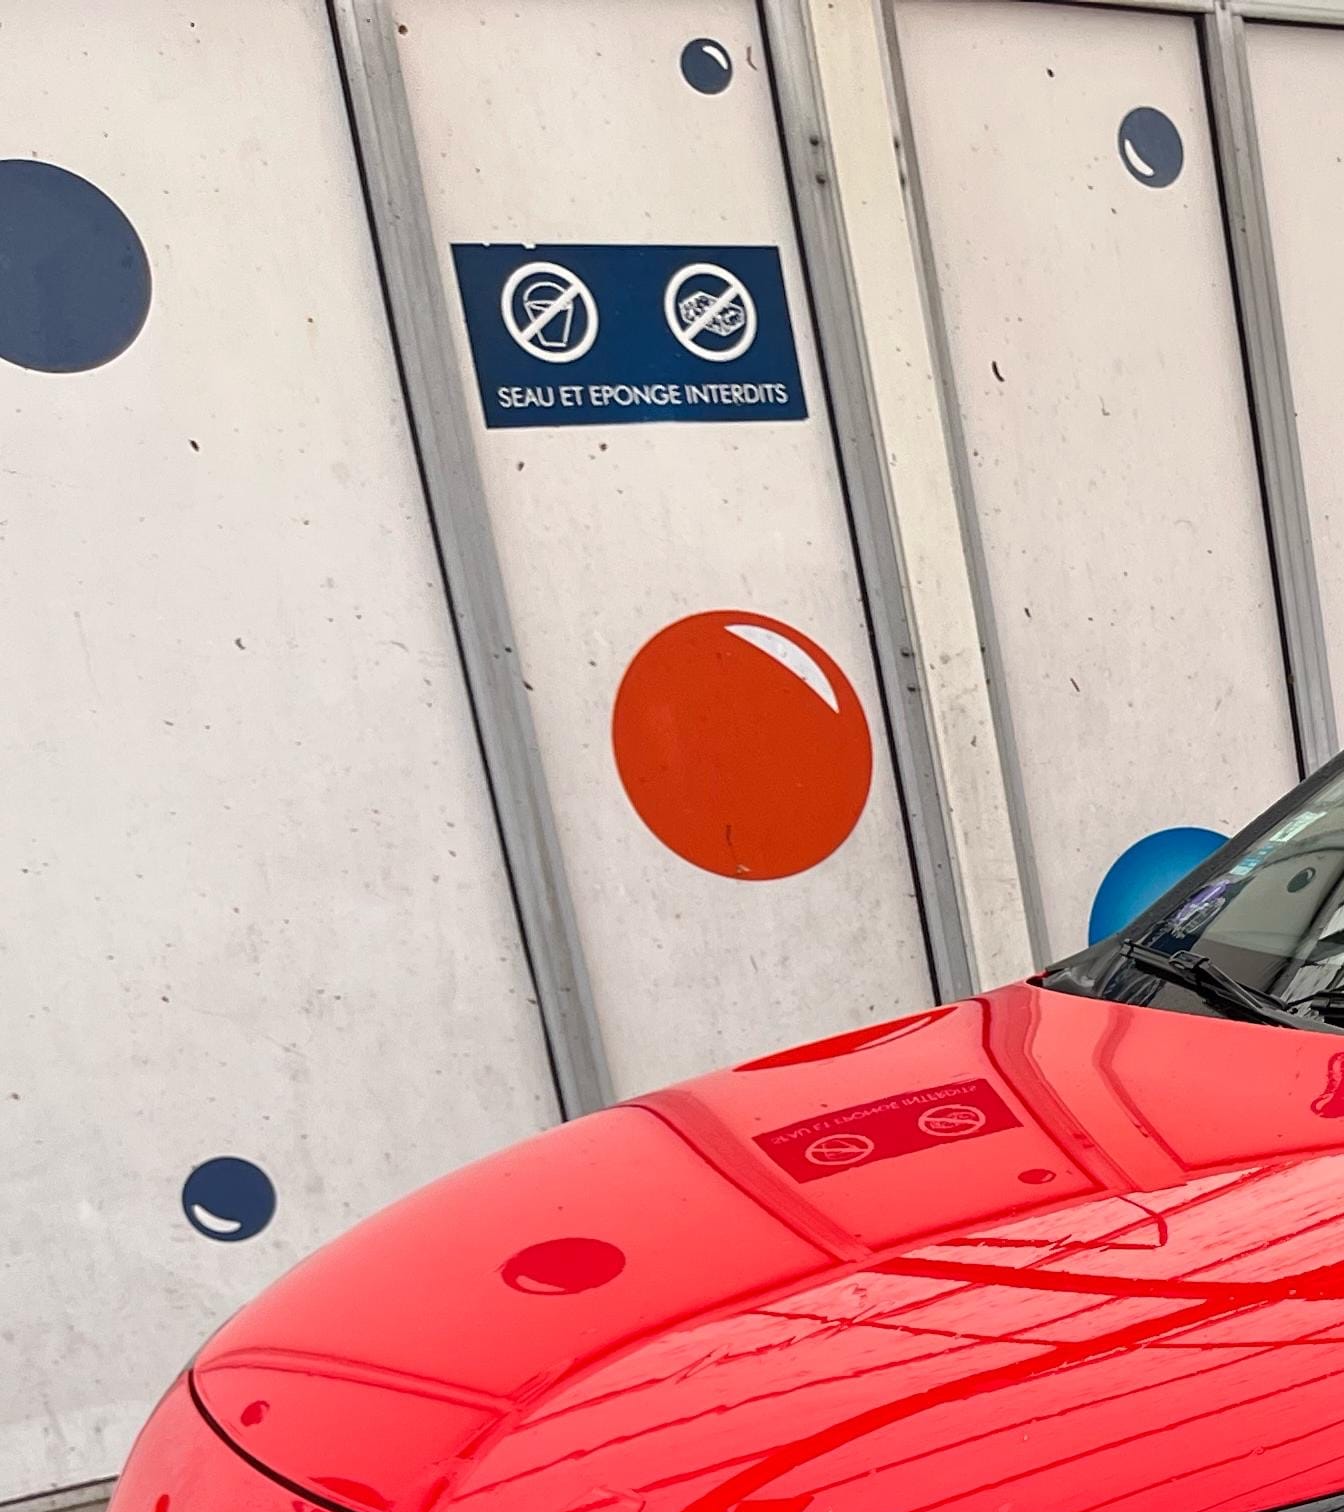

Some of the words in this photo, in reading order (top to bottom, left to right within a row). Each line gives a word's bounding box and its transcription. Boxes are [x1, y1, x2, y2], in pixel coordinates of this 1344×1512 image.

[497, 386, 554, 408] SEAU
[559, 385, 584, 407] ET
[588, 383, 682, 407] EPONGE
[685, 382, 789, 405] INTERDITS
